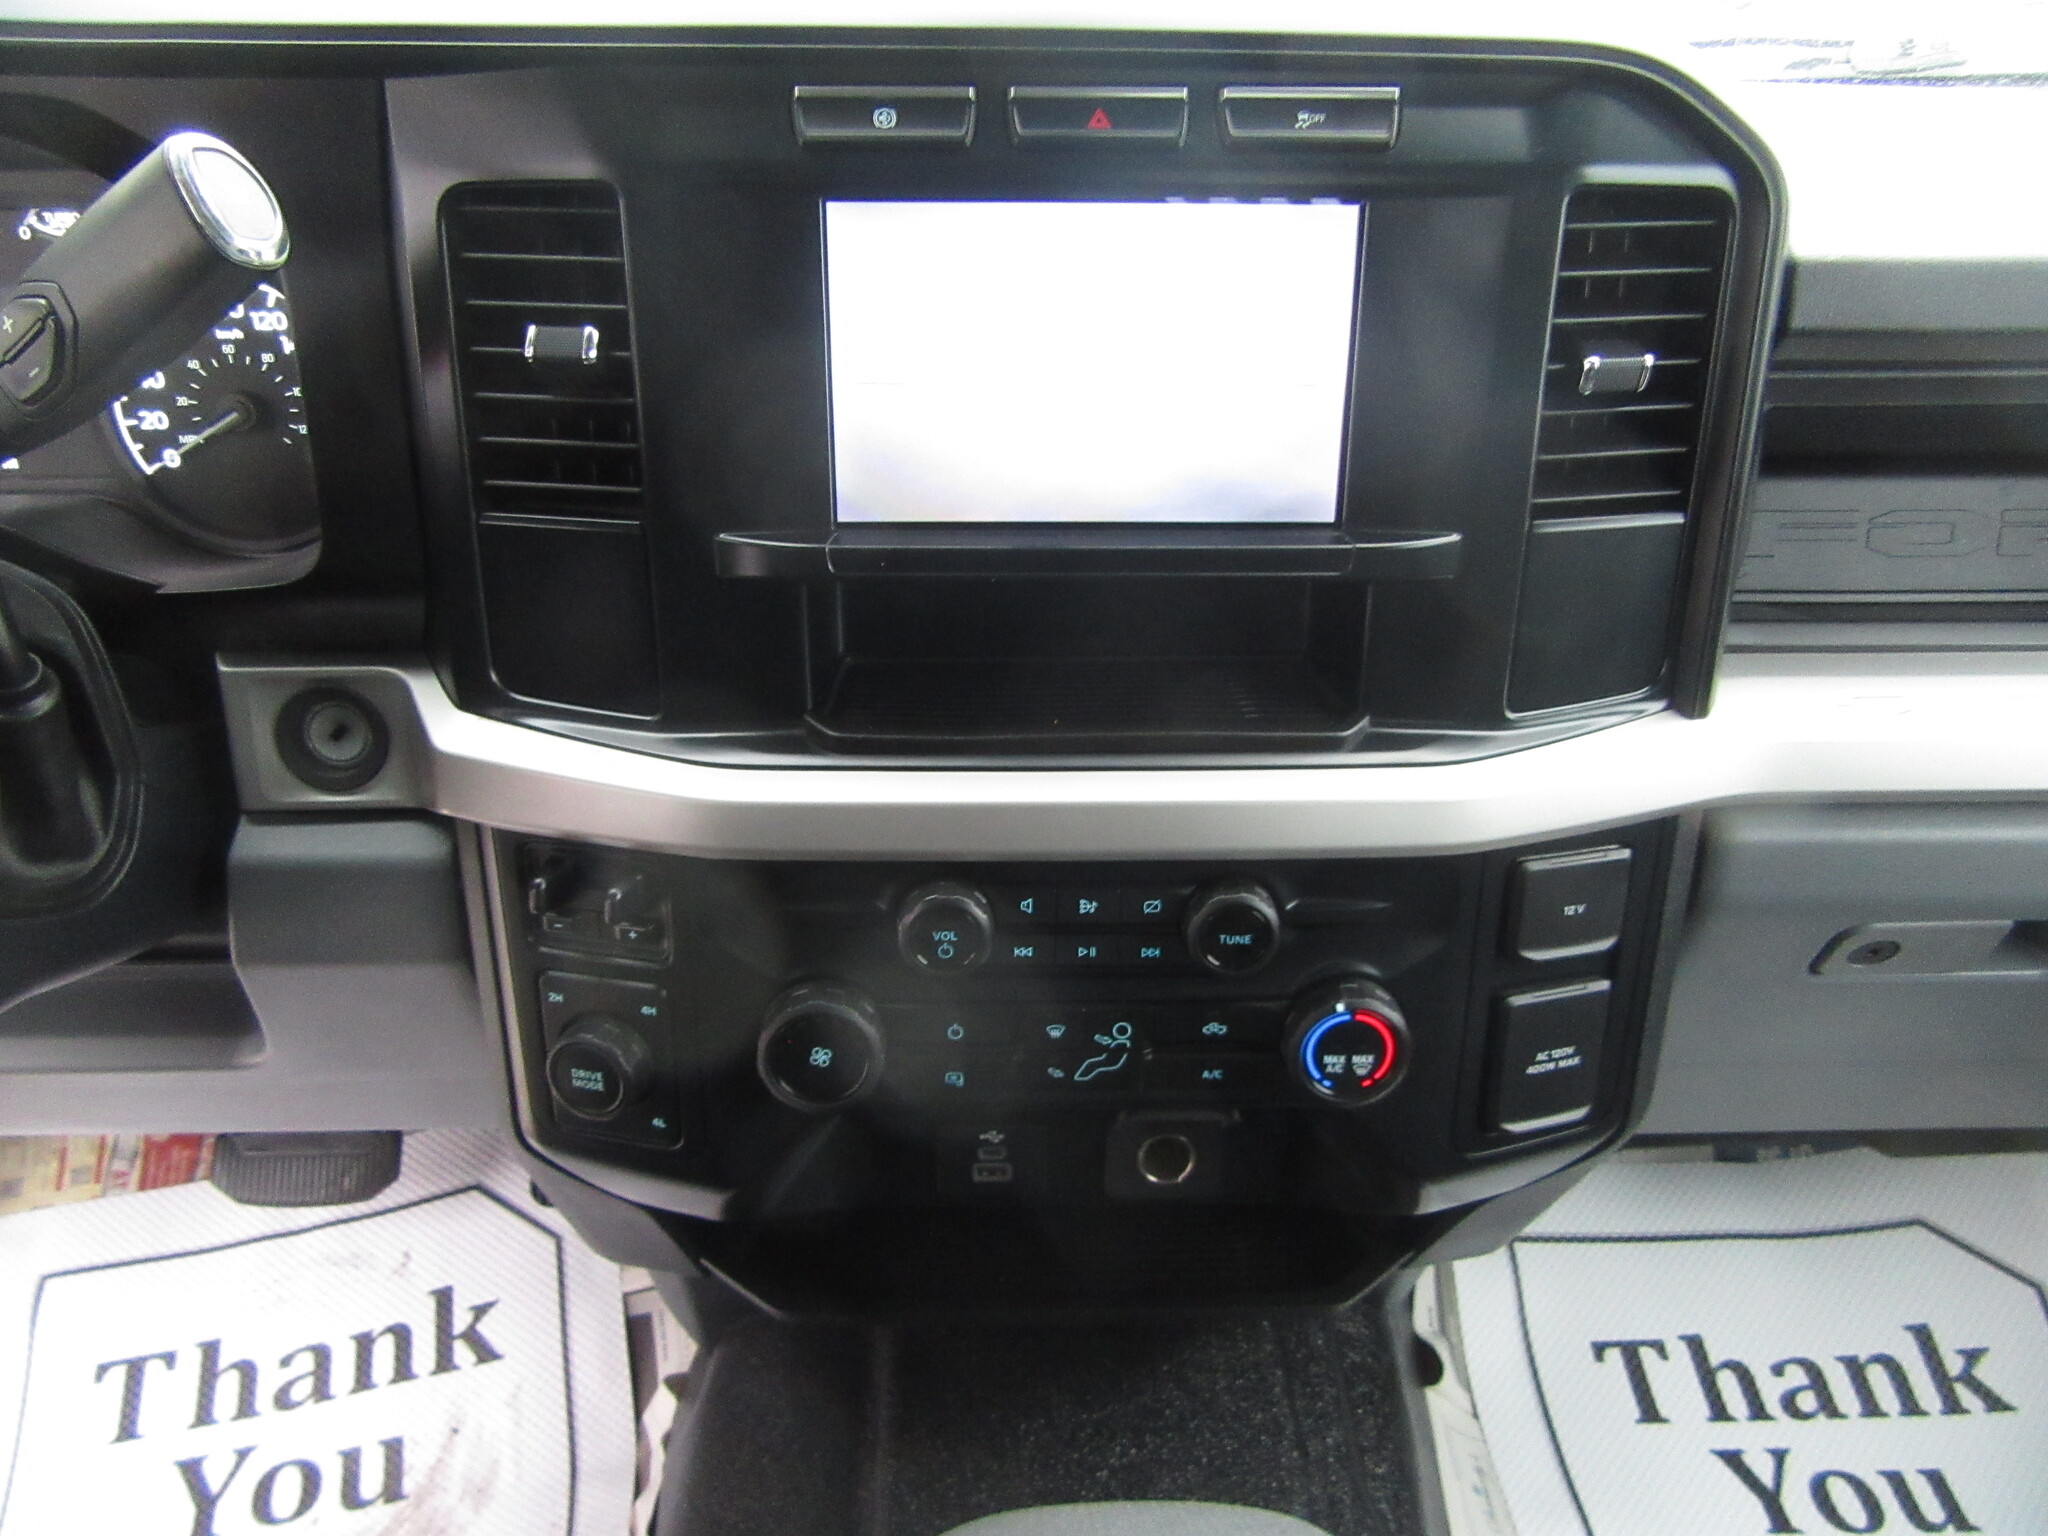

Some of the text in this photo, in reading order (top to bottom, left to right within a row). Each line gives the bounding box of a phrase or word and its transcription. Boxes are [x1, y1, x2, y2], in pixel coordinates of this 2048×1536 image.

[1309, 113, 1326, 123] OFF
[19, 225, 31, 240] 0
[249, 311, 288, 331] 120
[222, 344, 235, 354] 60
[261, 353, 275, 363] 80
[187, 360, 201, 370] 40
[176, 396, 188, 406] 20
[137, 411, 169, 430] 20
[163, 449, 181, 468] 0
[1563, 903, 1587, 916] 12V
[933, 931, 958, 941] VOL
[1219, 934, 1252, 945] TUNE
[548, 992, 564, 1003] 2H
[640, 1005, 657, 1016] 4H
[1323, 1054, 1375, 1064] MAX MAX
[1534, 1050, 1550, 1062] AC
[1557, 1055, 1582, 1069] MAX
[571, 1068, 603, 1081] DRIVE
[1202, 1069, 1224, 1080] A/C
[1325, 1064, 1343, 1074] A/C
[572, 1079, 605, 1092] MODE
[652, 1117, 667, 1128] 4L
[94, 1285, 504, 1445] Thank
[1591, 1323, 2018, 1424] Thank
[175, 1435, 409, 1536] You
[1710, 1447, 1980, 1536] You
